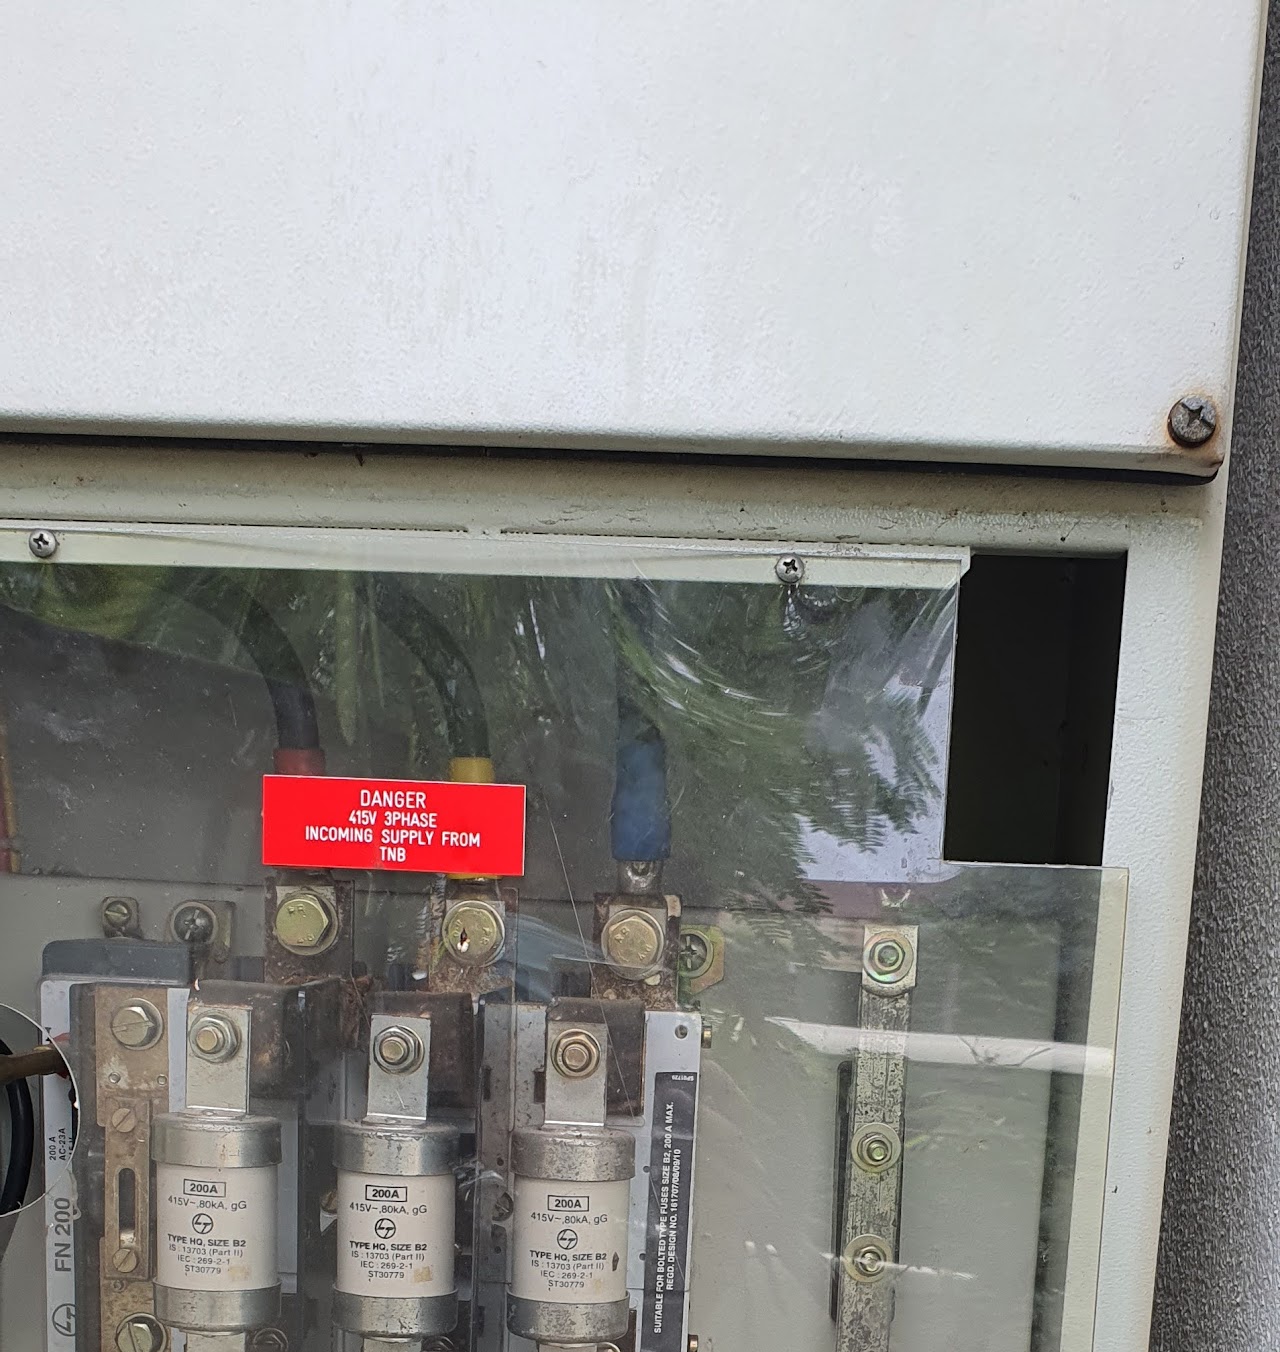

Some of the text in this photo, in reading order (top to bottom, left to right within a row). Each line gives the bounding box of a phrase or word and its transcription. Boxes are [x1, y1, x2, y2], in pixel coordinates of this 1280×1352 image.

[360, 789, 426, 809] DANGER
[349, 811, 437, 828] 415V 3PHASE
[305, 826, 480, 847] INCOMING SUPPLY FROM
[380, 846, 406, 862] TNB
[49, 1144, 57, 1161] 200
[190, 1183, 218, 1194] 200A
[372, 1189, 399, 1198] 200A
[231, 1201, 247, 1211] gG
[555, 1199, 581, 1208] 200A
[412, 1205, 427, 1215] gG
[594, 1214, 607, 1225] gG
[654, 1102, 674, 1334] SUITABLE FOR BOLTED TYPE FUSES SIZE B2, 200 A MAX.
[669, 1214, 677, 1229] NO.
[54, 1198, 72, 1272] FN 200
[168, 1234, 187, 1244] TYPE
[190, 1238, 205, 1247] HQ,
[208, 1239, 229, 1247] SIZE
[350, 1241, 370, 1249] TYPE
[668, 1230, 677, 1263] DESIGN
[178, 1254, 190, 1262] IEC
[183, 1247, 206, 1255] 13703
[234, 1250, 243, 1258] II)
[392, 1253, 412, 1261] (Part
[530, 1250, 551, 1259] TYPE
[554, 1254, 569, 1262] HQ,
[185, 1265, 221, 1274] ST30779
[666, 1264, 674, 1290] REGD.
